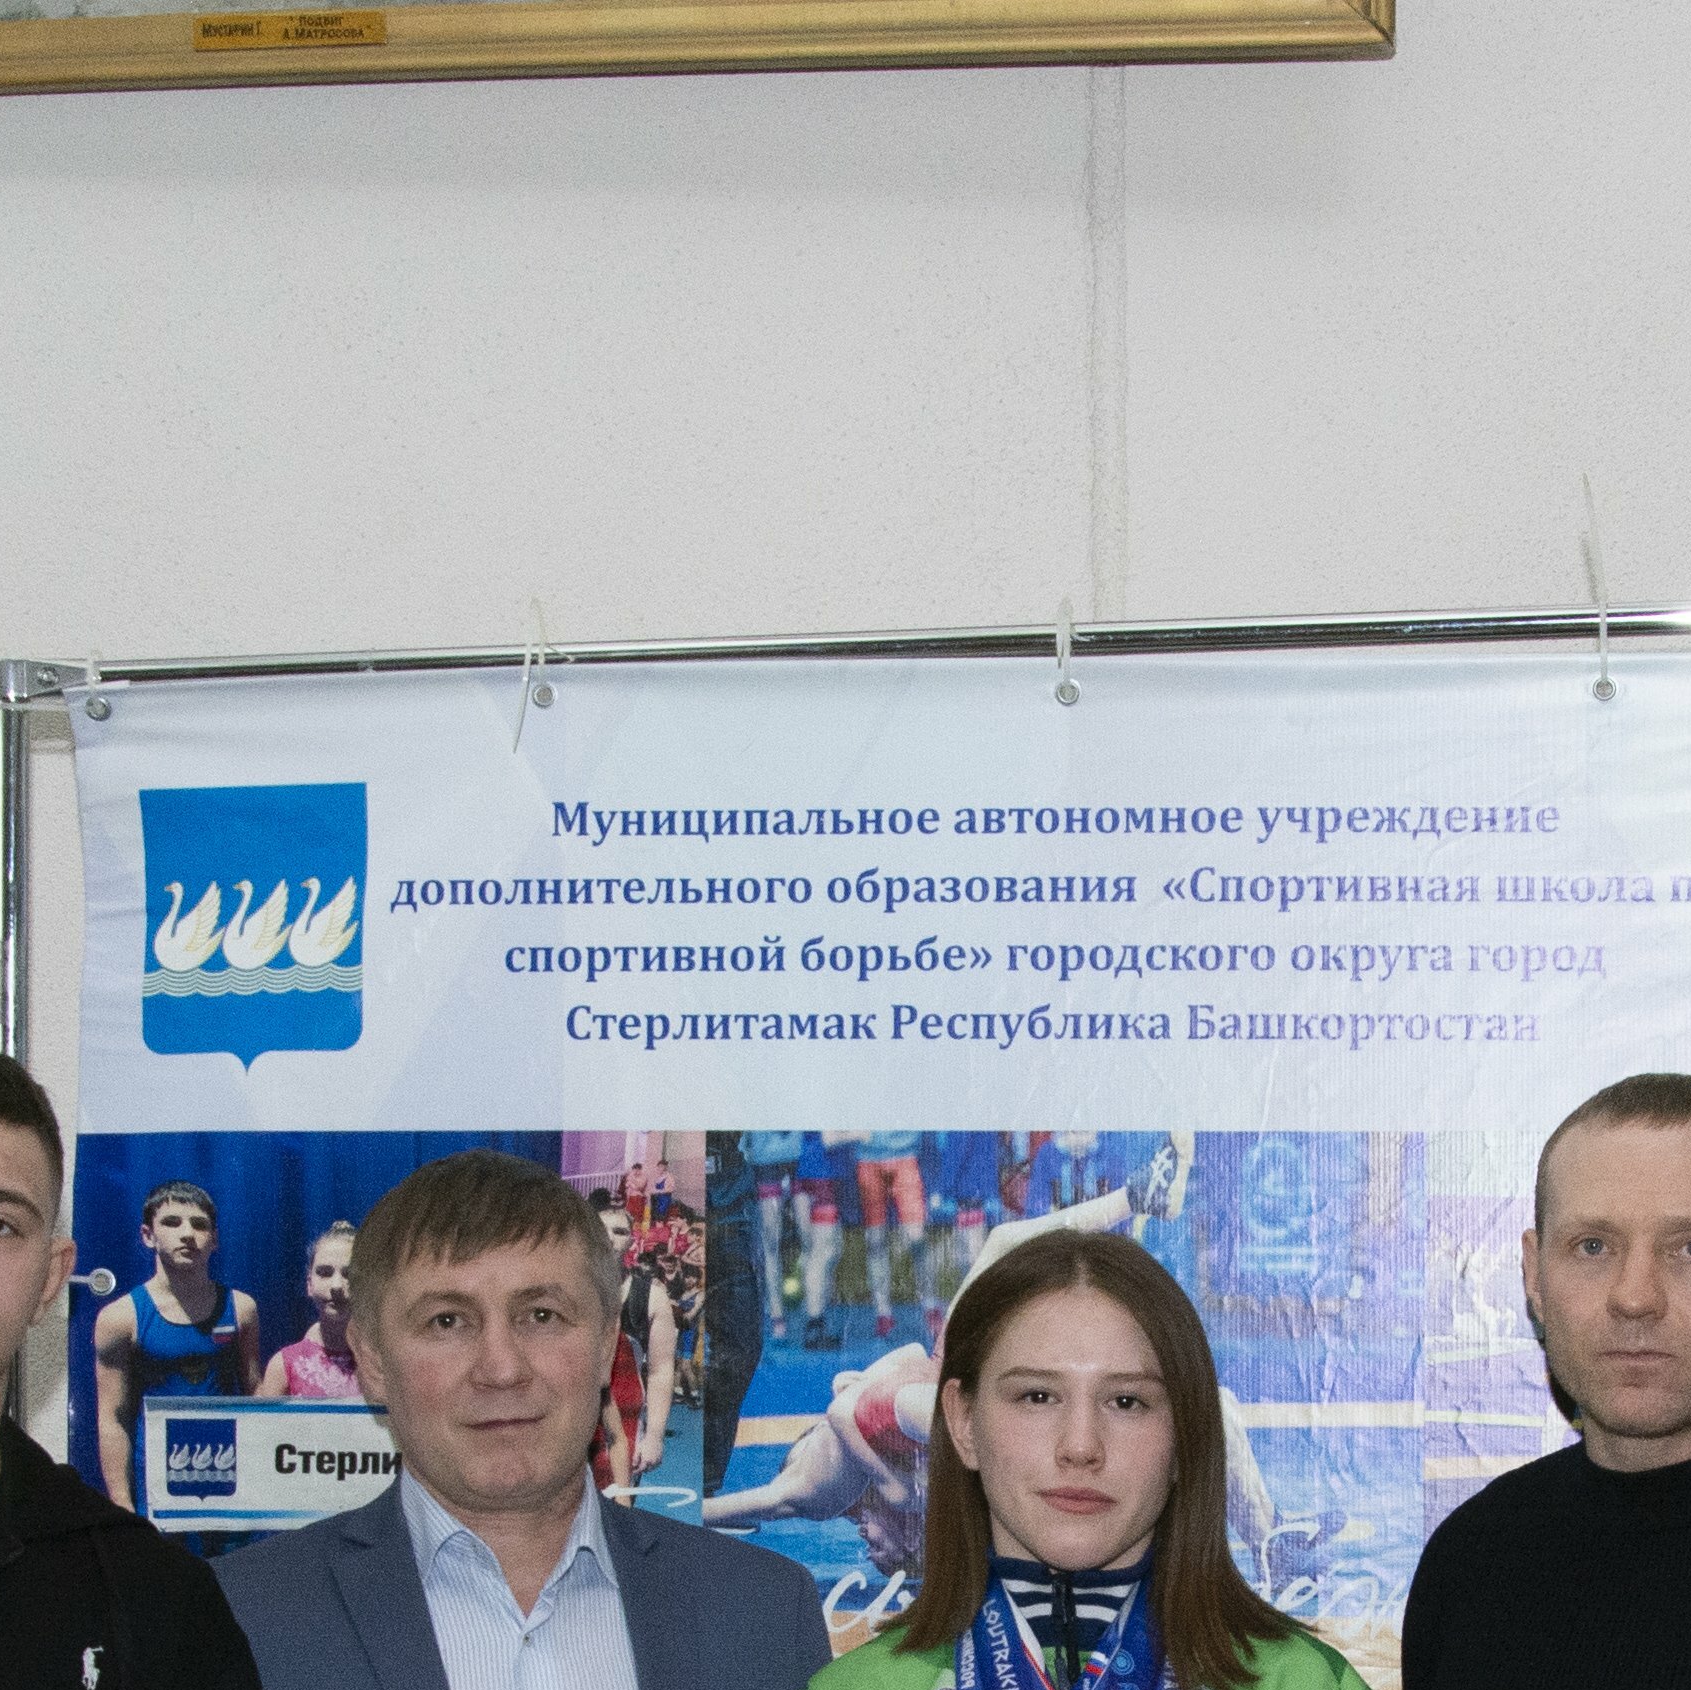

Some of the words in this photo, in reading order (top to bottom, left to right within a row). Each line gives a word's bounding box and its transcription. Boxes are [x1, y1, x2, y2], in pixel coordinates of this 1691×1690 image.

[552, 801, 941, 846] Муниципальное
[953, 805, 1244, 836] автономное
[1256, 803, 1560, 844] учреждение
[390, 877, 813, 914] дополнительного
[826, 867, 1138, 913] образования
[1162, 867, 1481, 913] «Спортивная
[1494, 876, 1656, 905] школа
[504, 936, 786, 983] спортивной
[799, 936, 994, 983] борьбе»
[1006, 944, 1276, 982] городского
[1290, 944, 1455, 982] округа
[1466, 944, 1607, 983] город
[565, 1004, 877, 1050] Стерлитамак
[889, 1003, 1173, 1051] Республика
[1186, 1003, 1541, 1051] Башкортостан
[274, 1443, 403, 1481] Стерли
